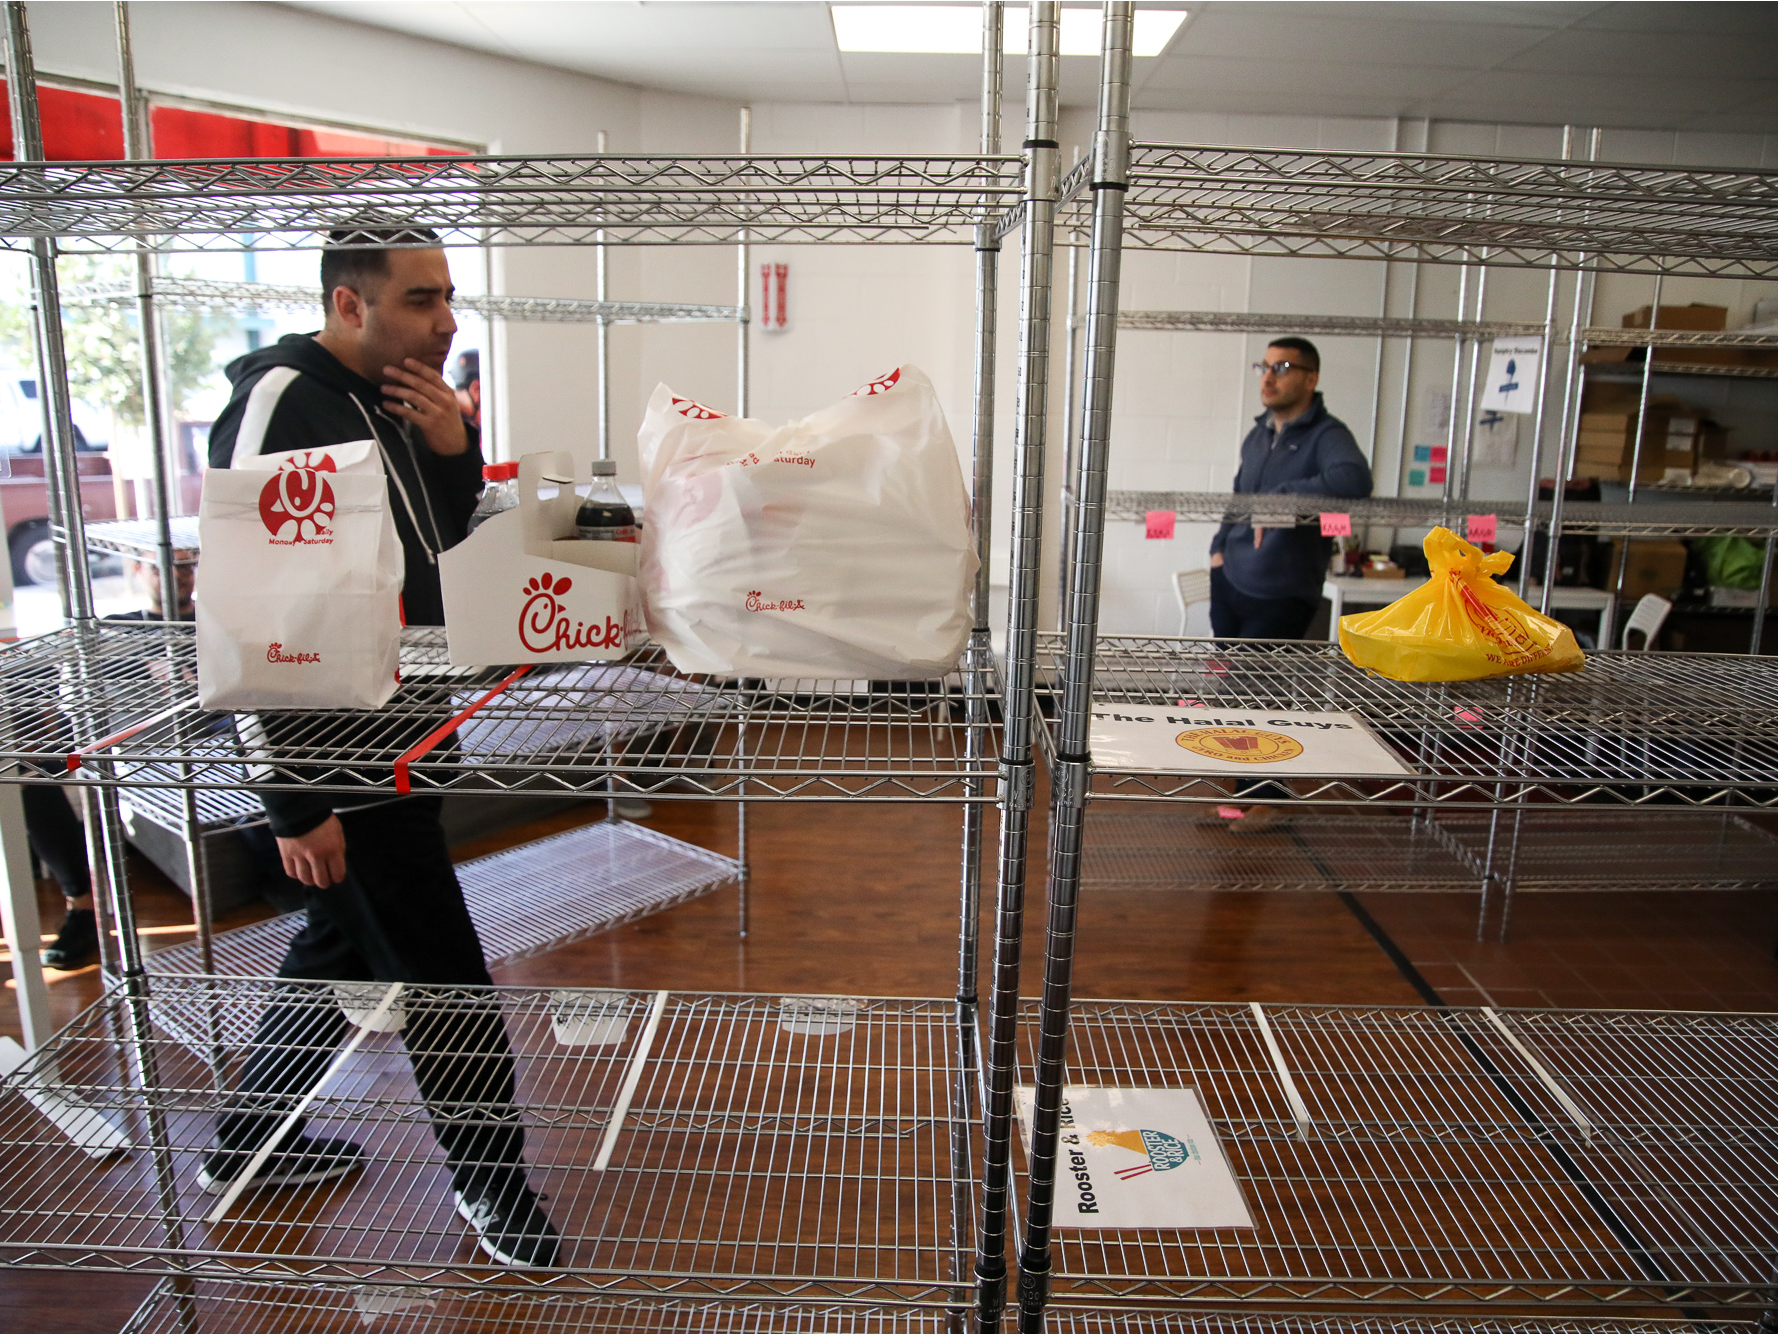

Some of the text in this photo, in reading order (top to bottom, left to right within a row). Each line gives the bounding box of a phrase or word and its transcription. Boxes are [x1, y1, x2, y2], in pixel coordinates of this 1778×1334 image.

[774, 456, 815, 468] aturday
[1486, 653, 1502, 664] WE
[1504, 657, 1521, 667] ARE
[1091, 712, 1353, 730] The Halal Guys
[1060, 1134, 1080, 1145] &
[1142, 1131, 1170, 1170] ROOSTER
[1069, 1149, 1100, 1214] Rooster
